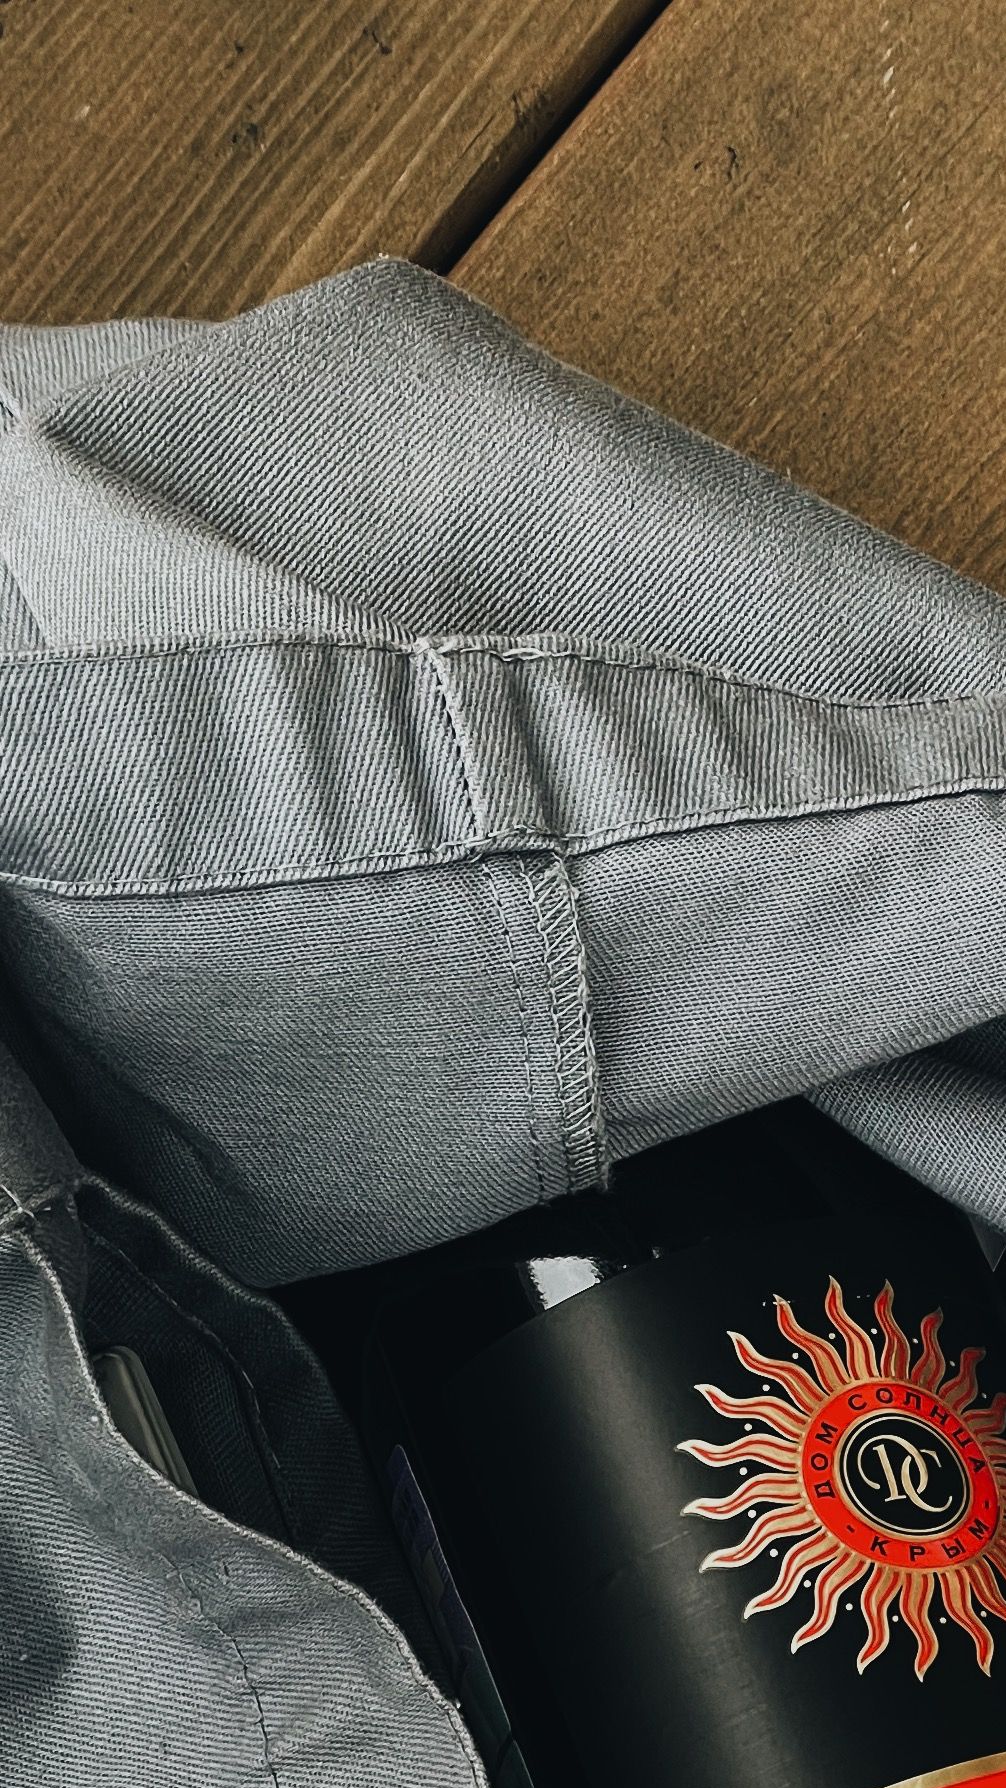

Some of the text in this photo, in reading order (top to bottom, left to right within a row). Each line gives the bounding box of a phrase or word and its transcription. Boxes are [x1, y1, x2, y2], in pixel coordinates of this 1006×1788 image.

[811, 1386, 987, 1500] ДОМ СОЛНЦА
[870, 1517, 990, 1562] КРЫМ
